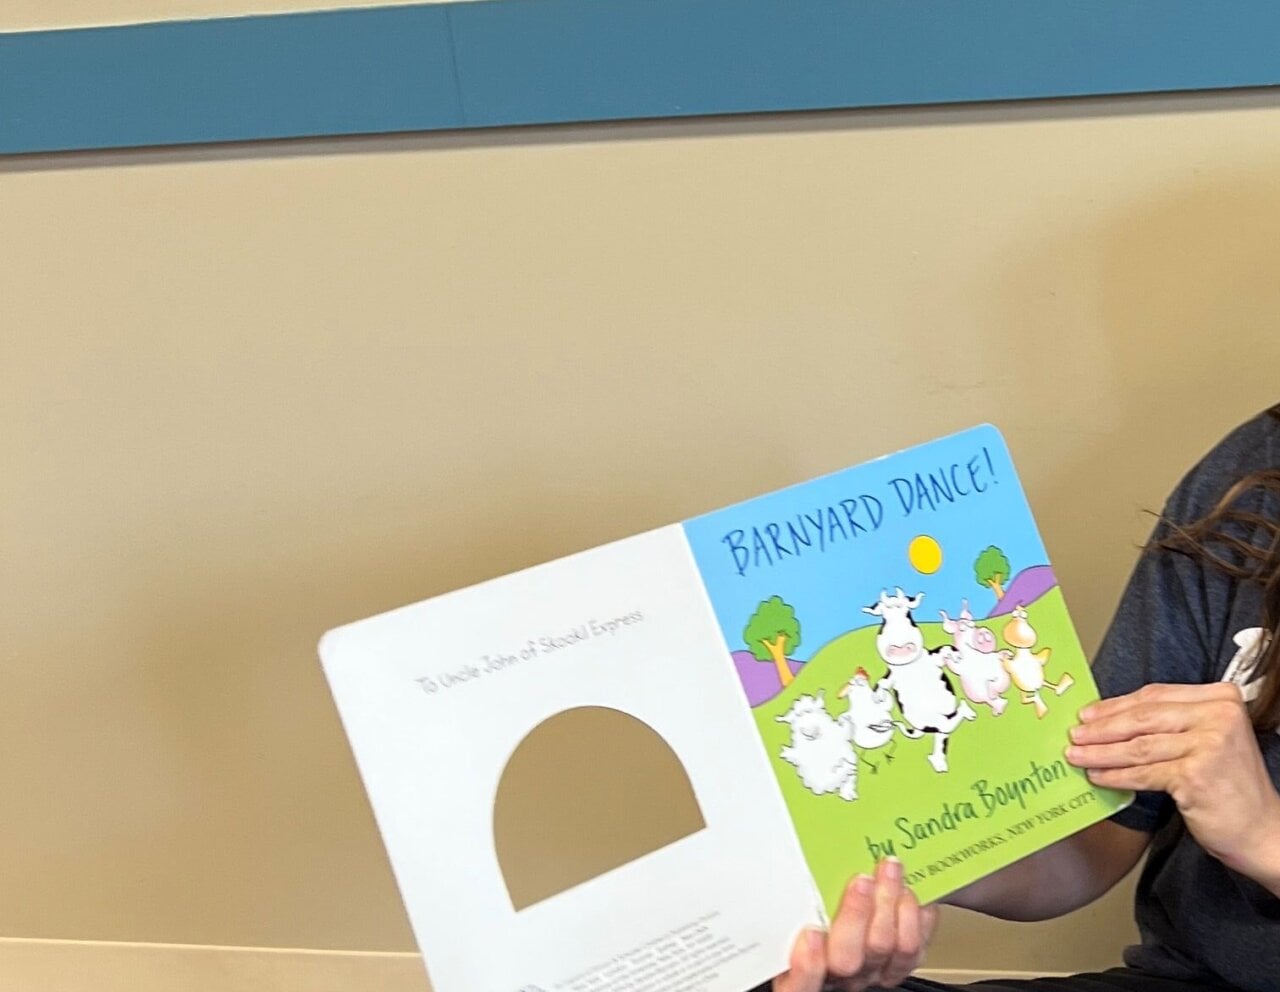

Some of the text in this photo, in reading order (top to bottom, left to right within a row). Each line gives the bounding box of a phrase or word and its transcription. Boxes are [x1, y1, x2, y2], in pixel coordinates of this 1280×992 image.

[721, 446, 999, 577] BARNYARD DANCE!
[894, 801, 979, 850] Sandra
[970, 759, 1068, 818] Boynton
[1007, 814, 1037, 841] NEW
[1036, 803, 1073, 827] YORK
[1069, 788, 1098, 811] CITY
